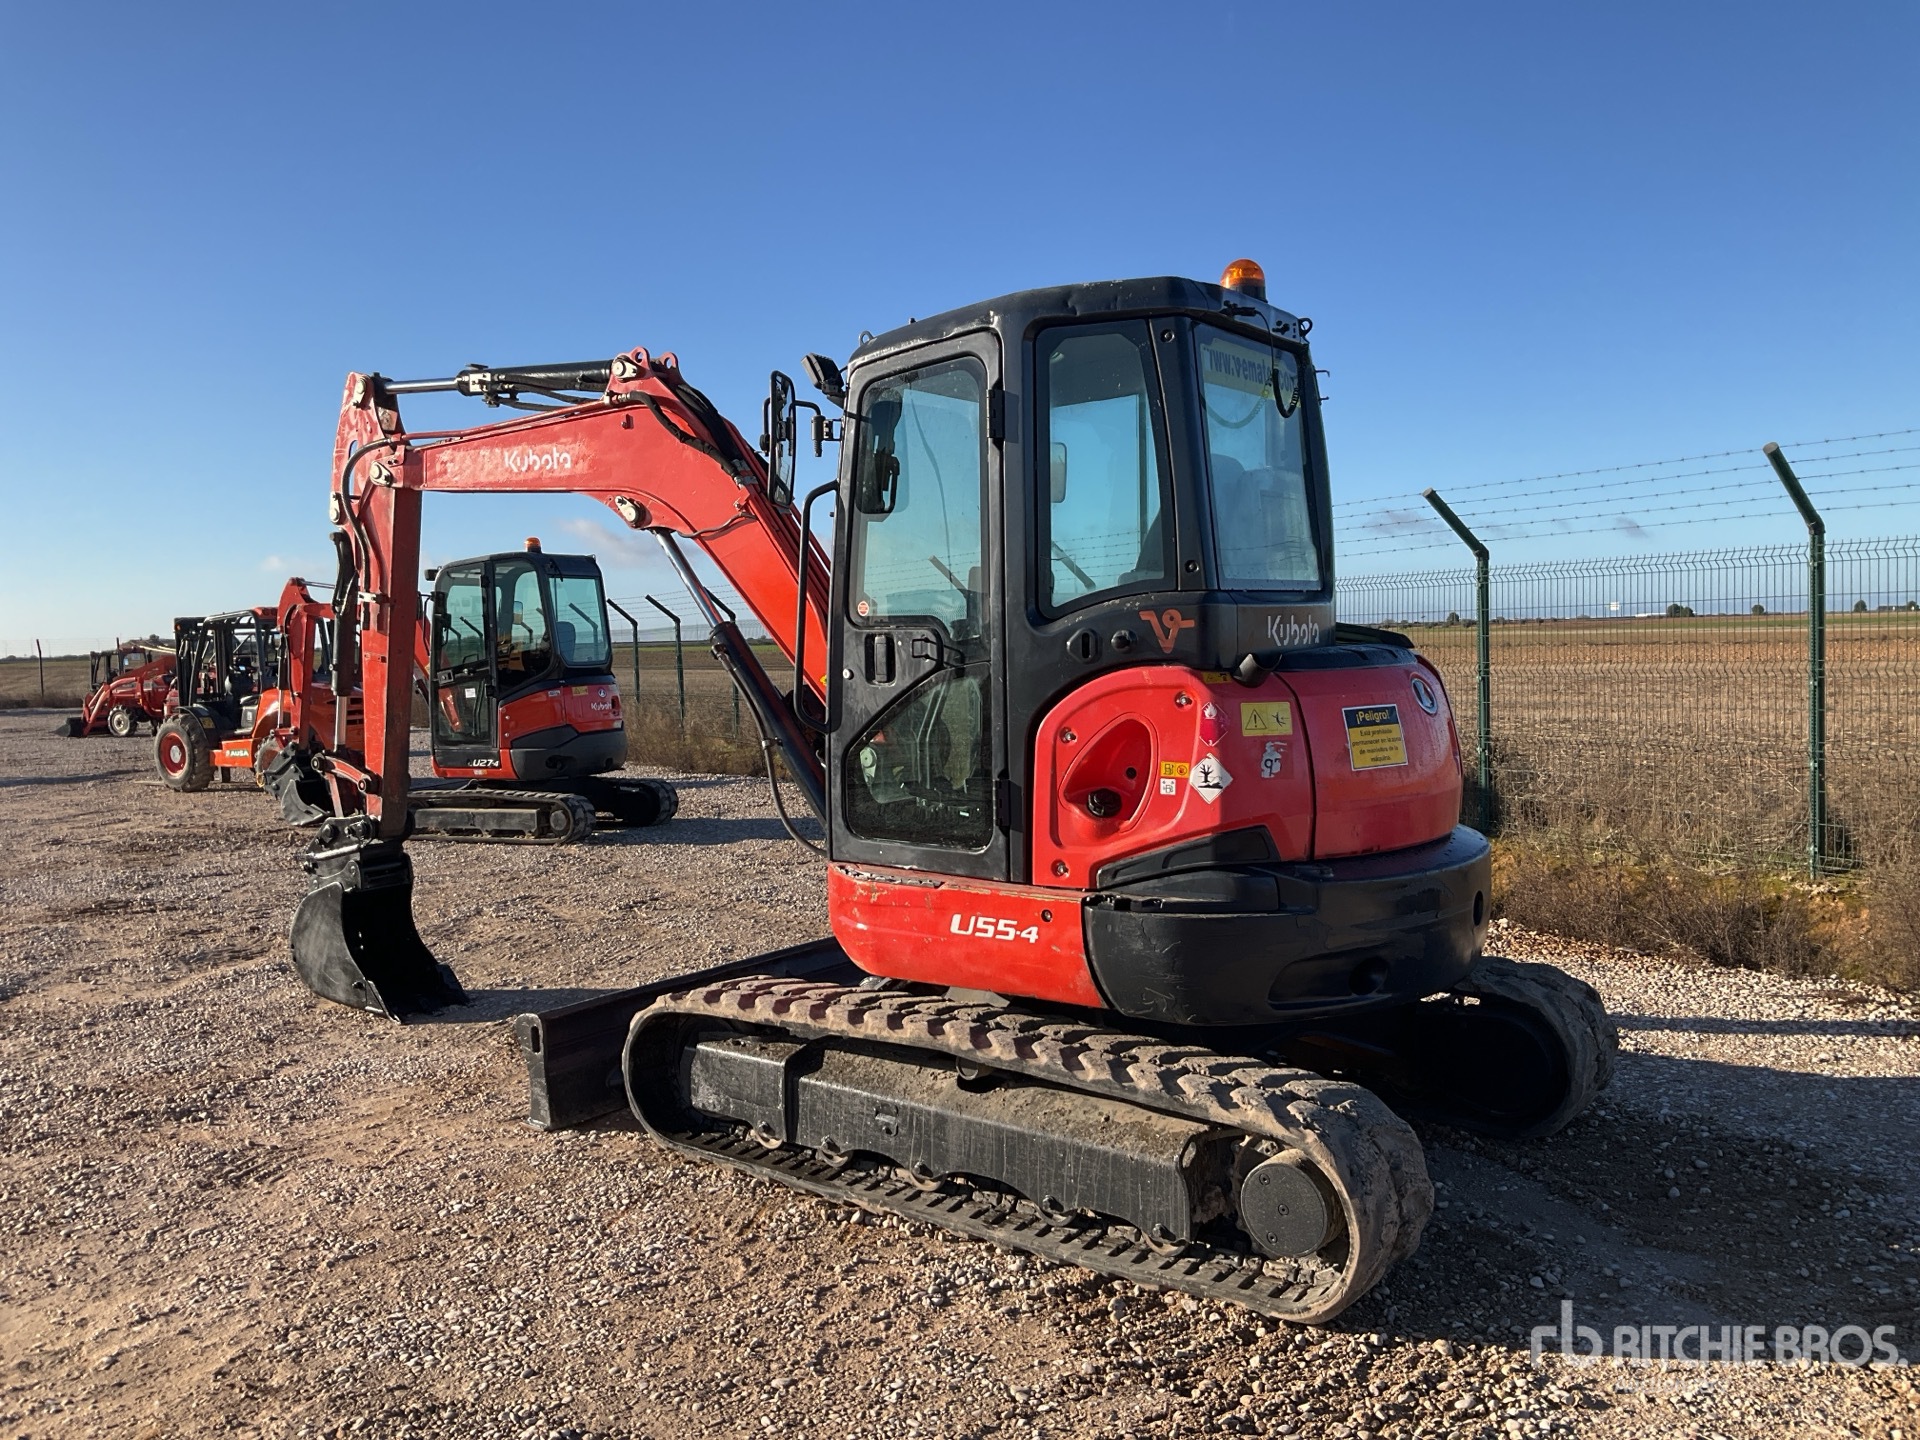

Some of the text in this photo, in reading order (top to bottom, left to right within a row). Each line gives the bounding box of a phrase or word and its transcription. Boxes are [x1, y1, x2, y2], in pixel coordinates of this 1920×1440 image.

[504, 447, 572, 472] Kubota
[1267, 614, 1320, 647] Kubota
[1356, 709, 1390, 724] ¡Peligro!
[230, 749, 249, 757] AUSA
[950, 913, 1039, 943] U55-4
